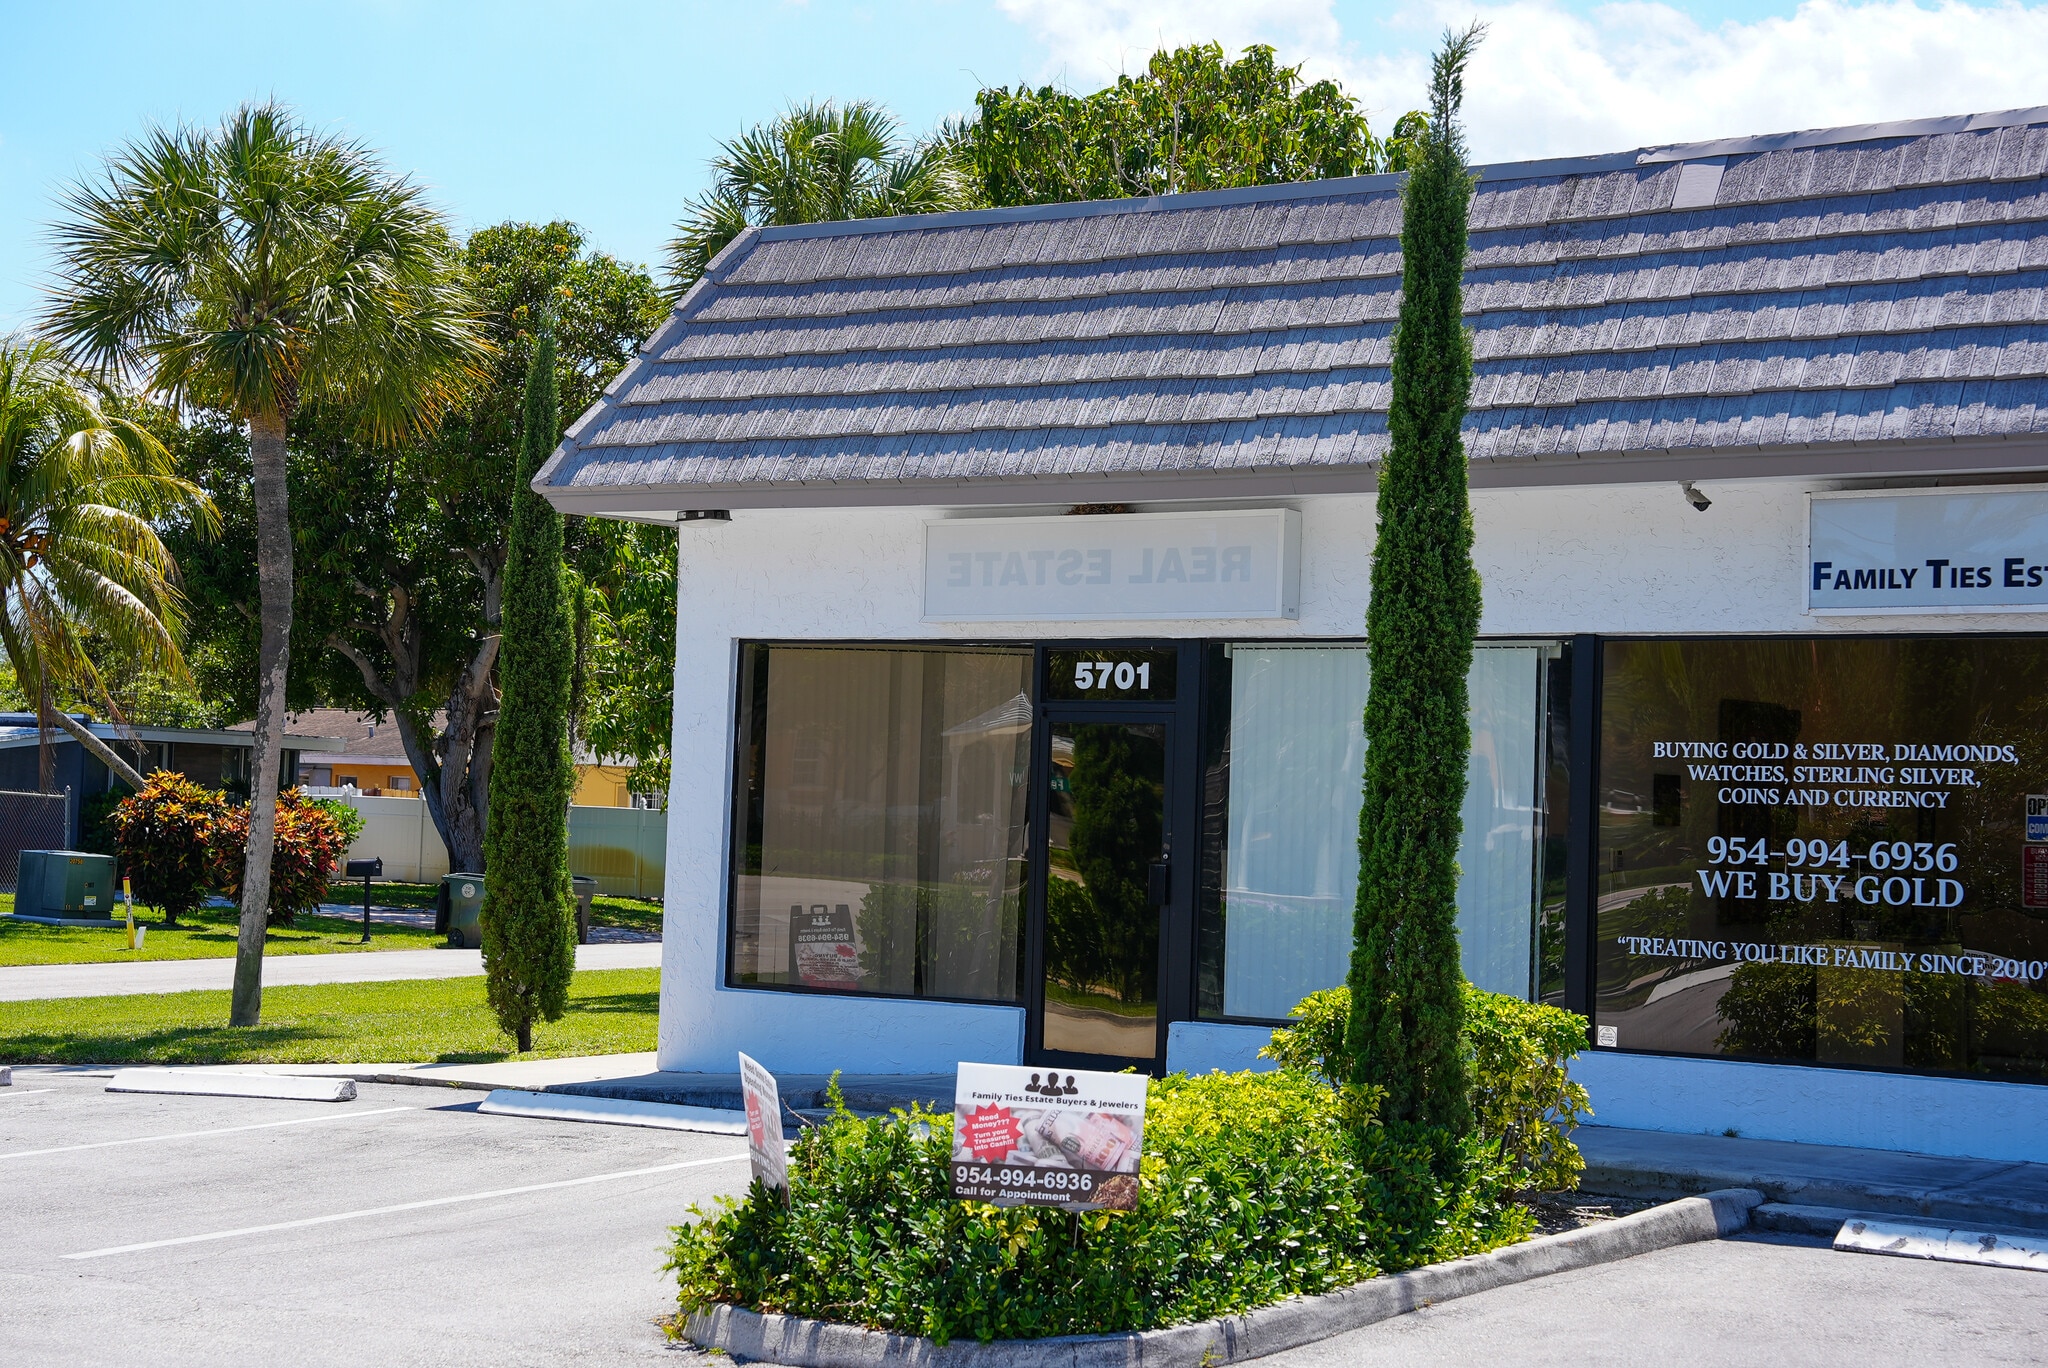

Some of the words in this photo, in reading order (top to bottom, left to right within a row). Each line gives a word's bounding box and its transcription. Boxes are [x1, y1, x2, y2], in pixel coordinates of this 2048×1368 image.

[1074, 661, 1151, 691] 5701
[1652, 741, 1728, 759] BUYING
[1732, 742, 1789, 759] GOLD
[1793, 743, 1808, 760] &
[1812, 743, 1890, 763] SILVER,
[1893, 744, 2019, 765] DIAMONDS,
[1687, 764, 1789, 785] WATCHES,
[1793, 766, 1895, 784] STERLING
[1899, 767, 1981, 788] SILVER,
[1718, 787, 1780, 805] COINS
[1783, 789, 1830, 806] AND
[1833, 790, 1950, 809] CURRENCY
[2027, 798, 2048, 815] OP
[1706, 836, 1957, 875] 954-994-6936
[1696, 870, 1757, 899] WE
[1768, 872, 1845, 903] BUY
[1854, 876, 1964, 907] GOLD
[1616, 935, 1727, 960] “TREATING
[1731, 941, 1777, 962] YOU
[1781, 945, 1829, 966] LIKE
[1832, 947, 1916, 972] FAMILY
[1919, 953, 1986, 976] SINCE
[972, 1091, 1003, 1102] Family
[1005, 1093, 1023, 1102] Ties
[1025, 1095, 1054, 1104] Estate
[1056, 1097, 1088, 1107] Buyers
[1099, 1099, 1139, 1110] Jewelers
[972, 1118, 1010, 1130] Money???
[978, 1113, 999, 1122] Need
[974, 1131, 991, 1139] Turn
[992, 1128, 1008, 1138] your
[974, 1134, 1010, 1145] Treasures
[974, 1143, 989, 1151] into
[956, 1166, 1092, 1191] 954-994-6936
[956, 1186, 977, 1197] Call
[980, 1187, 996, 1197] for
[999, 1188, 1071, 1202] Appointment
